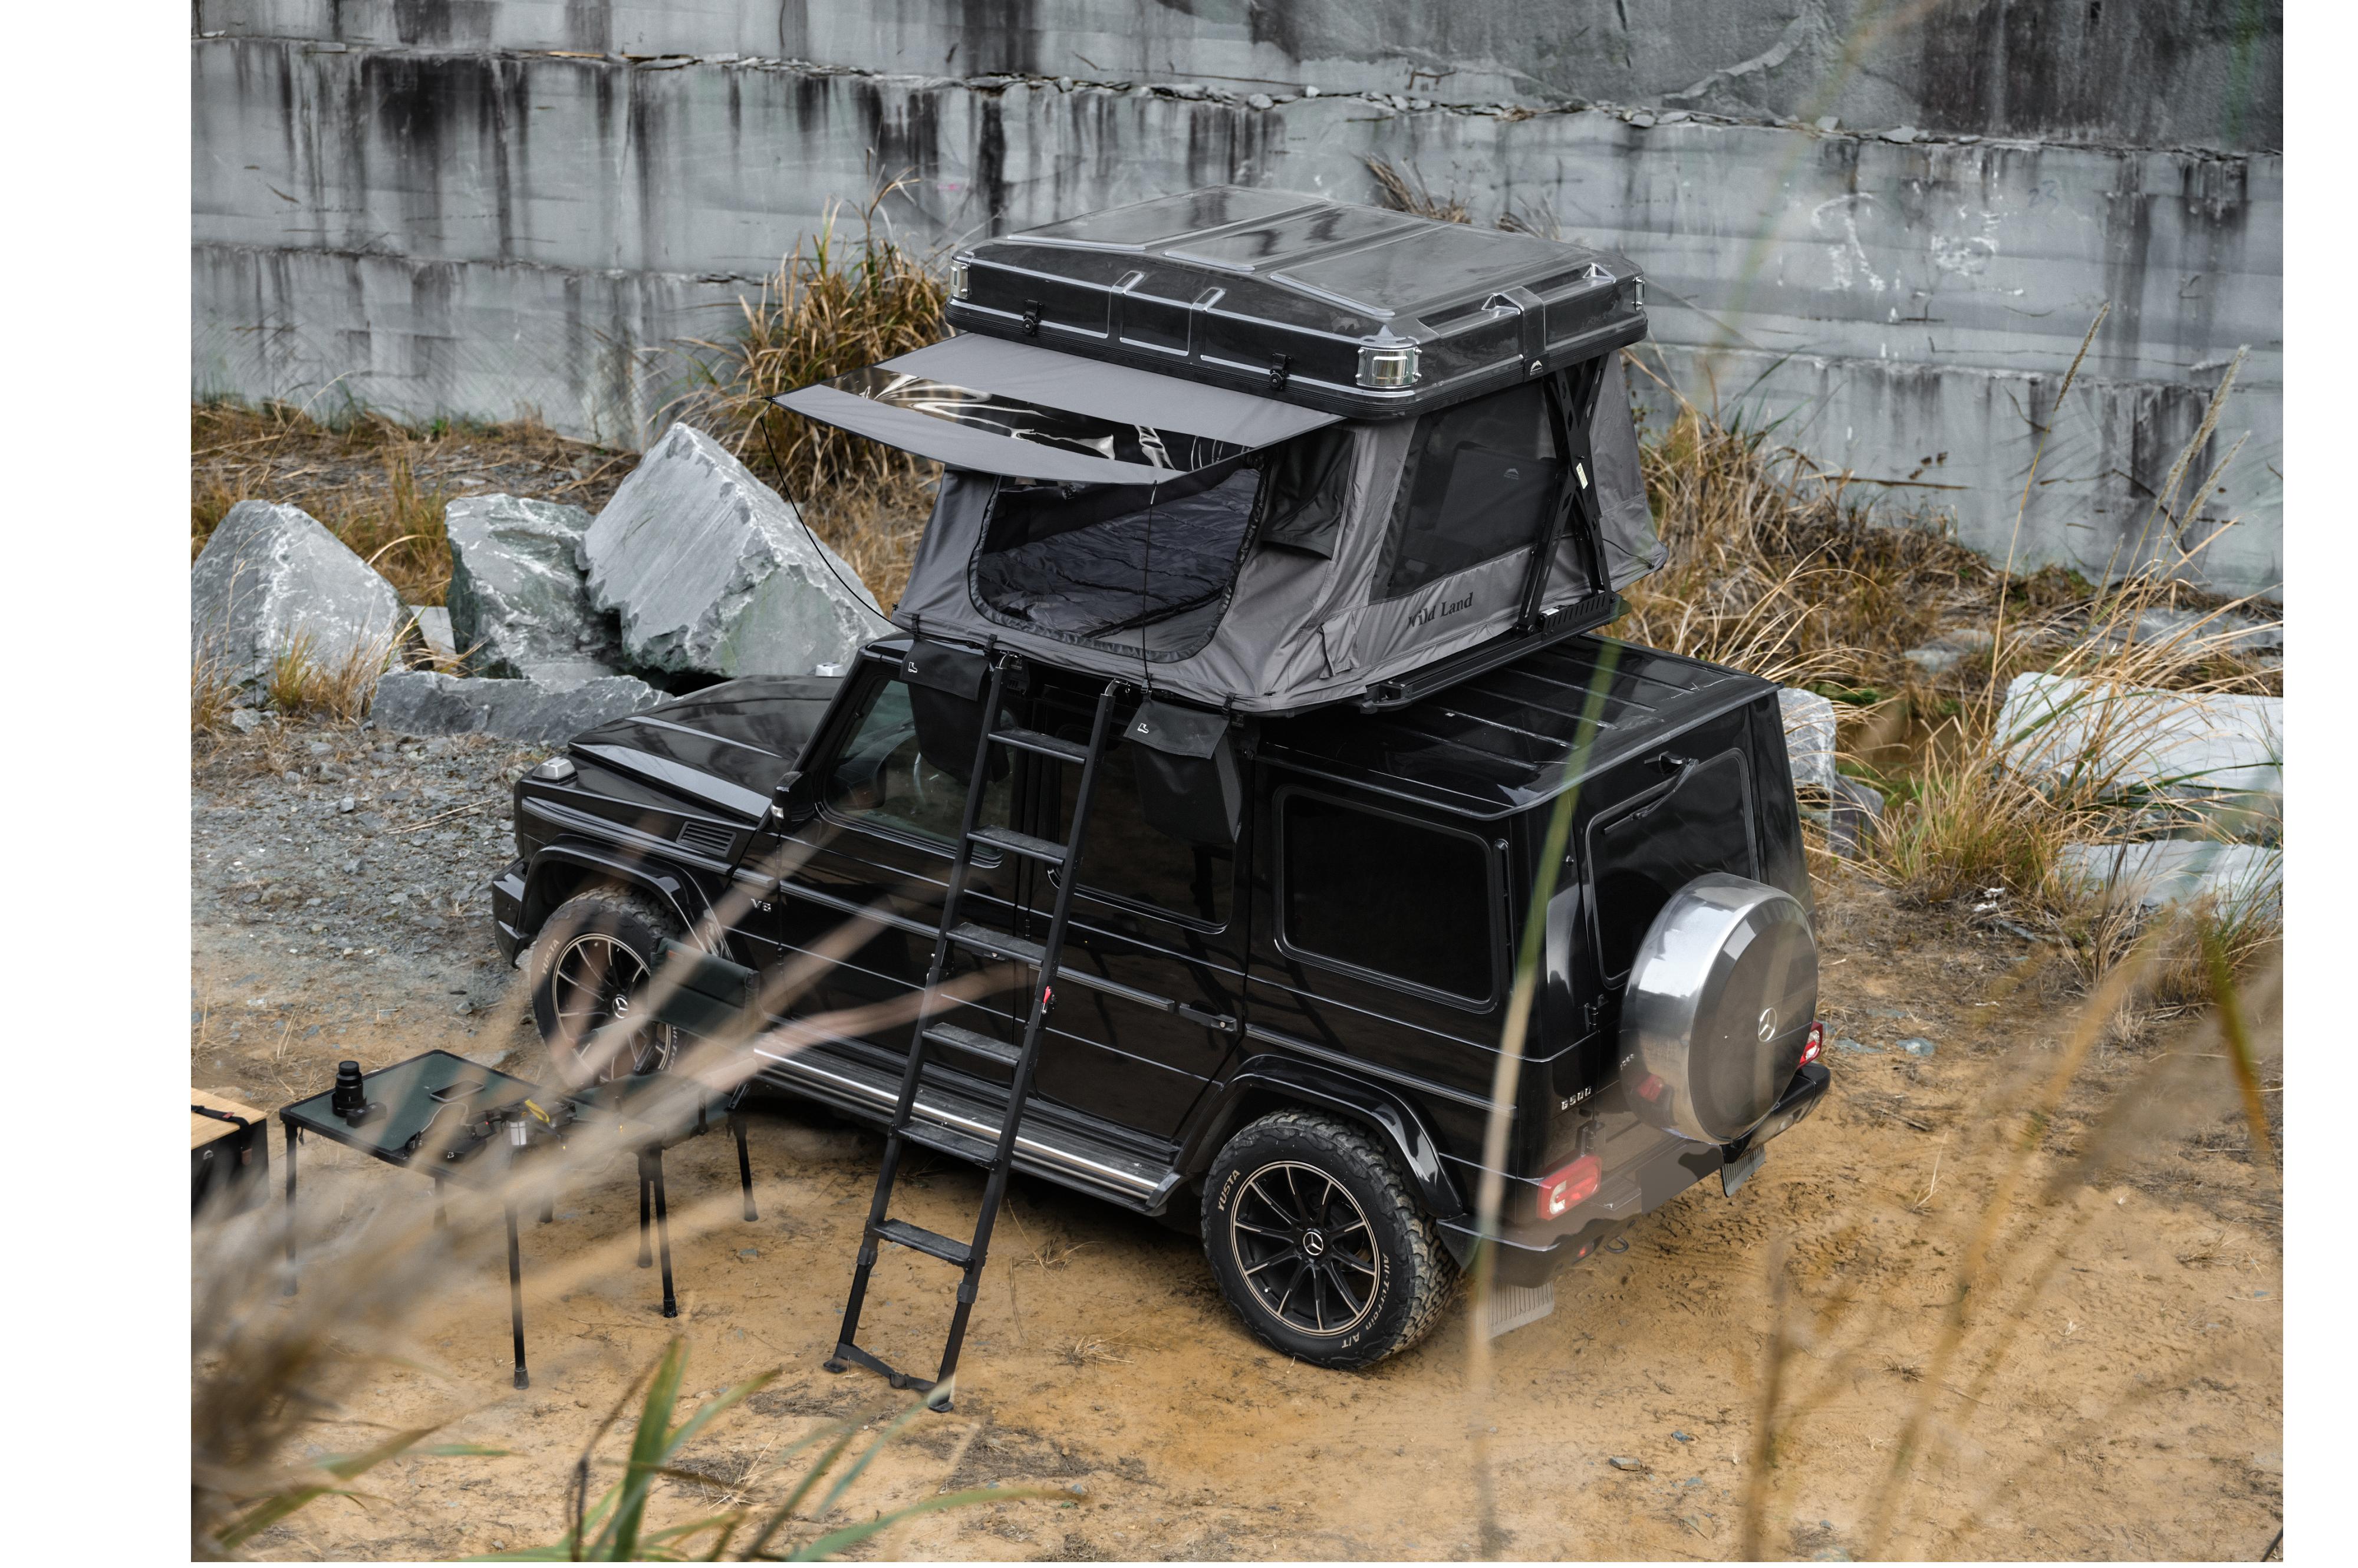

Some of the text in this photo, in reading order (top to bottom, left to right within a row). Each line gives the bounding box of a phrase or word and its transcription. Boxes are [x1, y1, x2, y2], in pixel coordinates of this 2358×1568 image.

[1441, 592, 1473, 617] Land
[750, 898, 771, 913] V8
[542, 939, 560, 974] YUSTA
[1218, 1170, 1241, 1211] YUSTA
[1342, 1332, 1360, 1349] A/T
